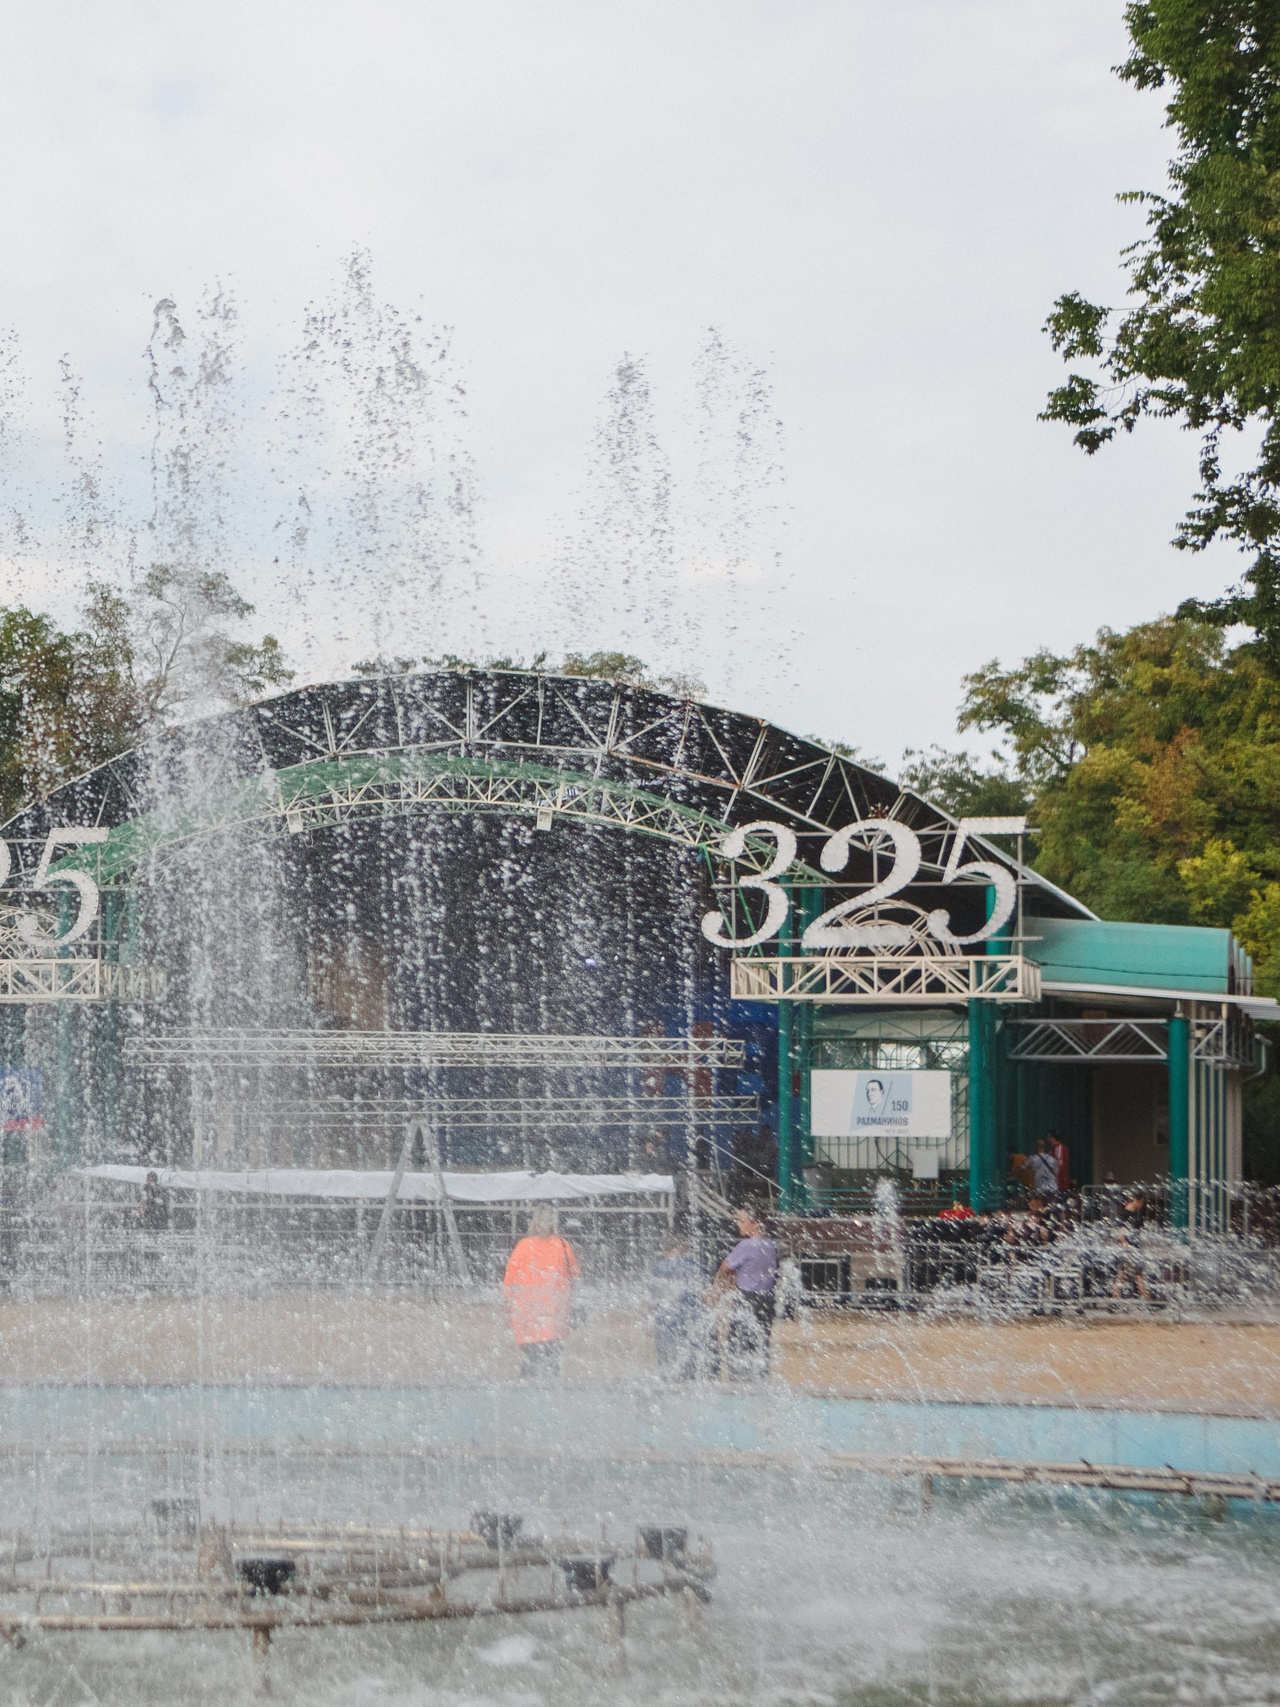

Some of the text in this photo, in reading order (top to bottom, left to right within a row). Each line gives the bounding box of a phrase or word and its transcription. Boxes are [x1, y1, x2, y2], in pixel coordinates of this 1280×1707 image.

[701, 816, 1027, 949] 325
[891, 1100, 909, 1112] 150
[856, 1116, 909, 1126] РАХМАНИНОВ
